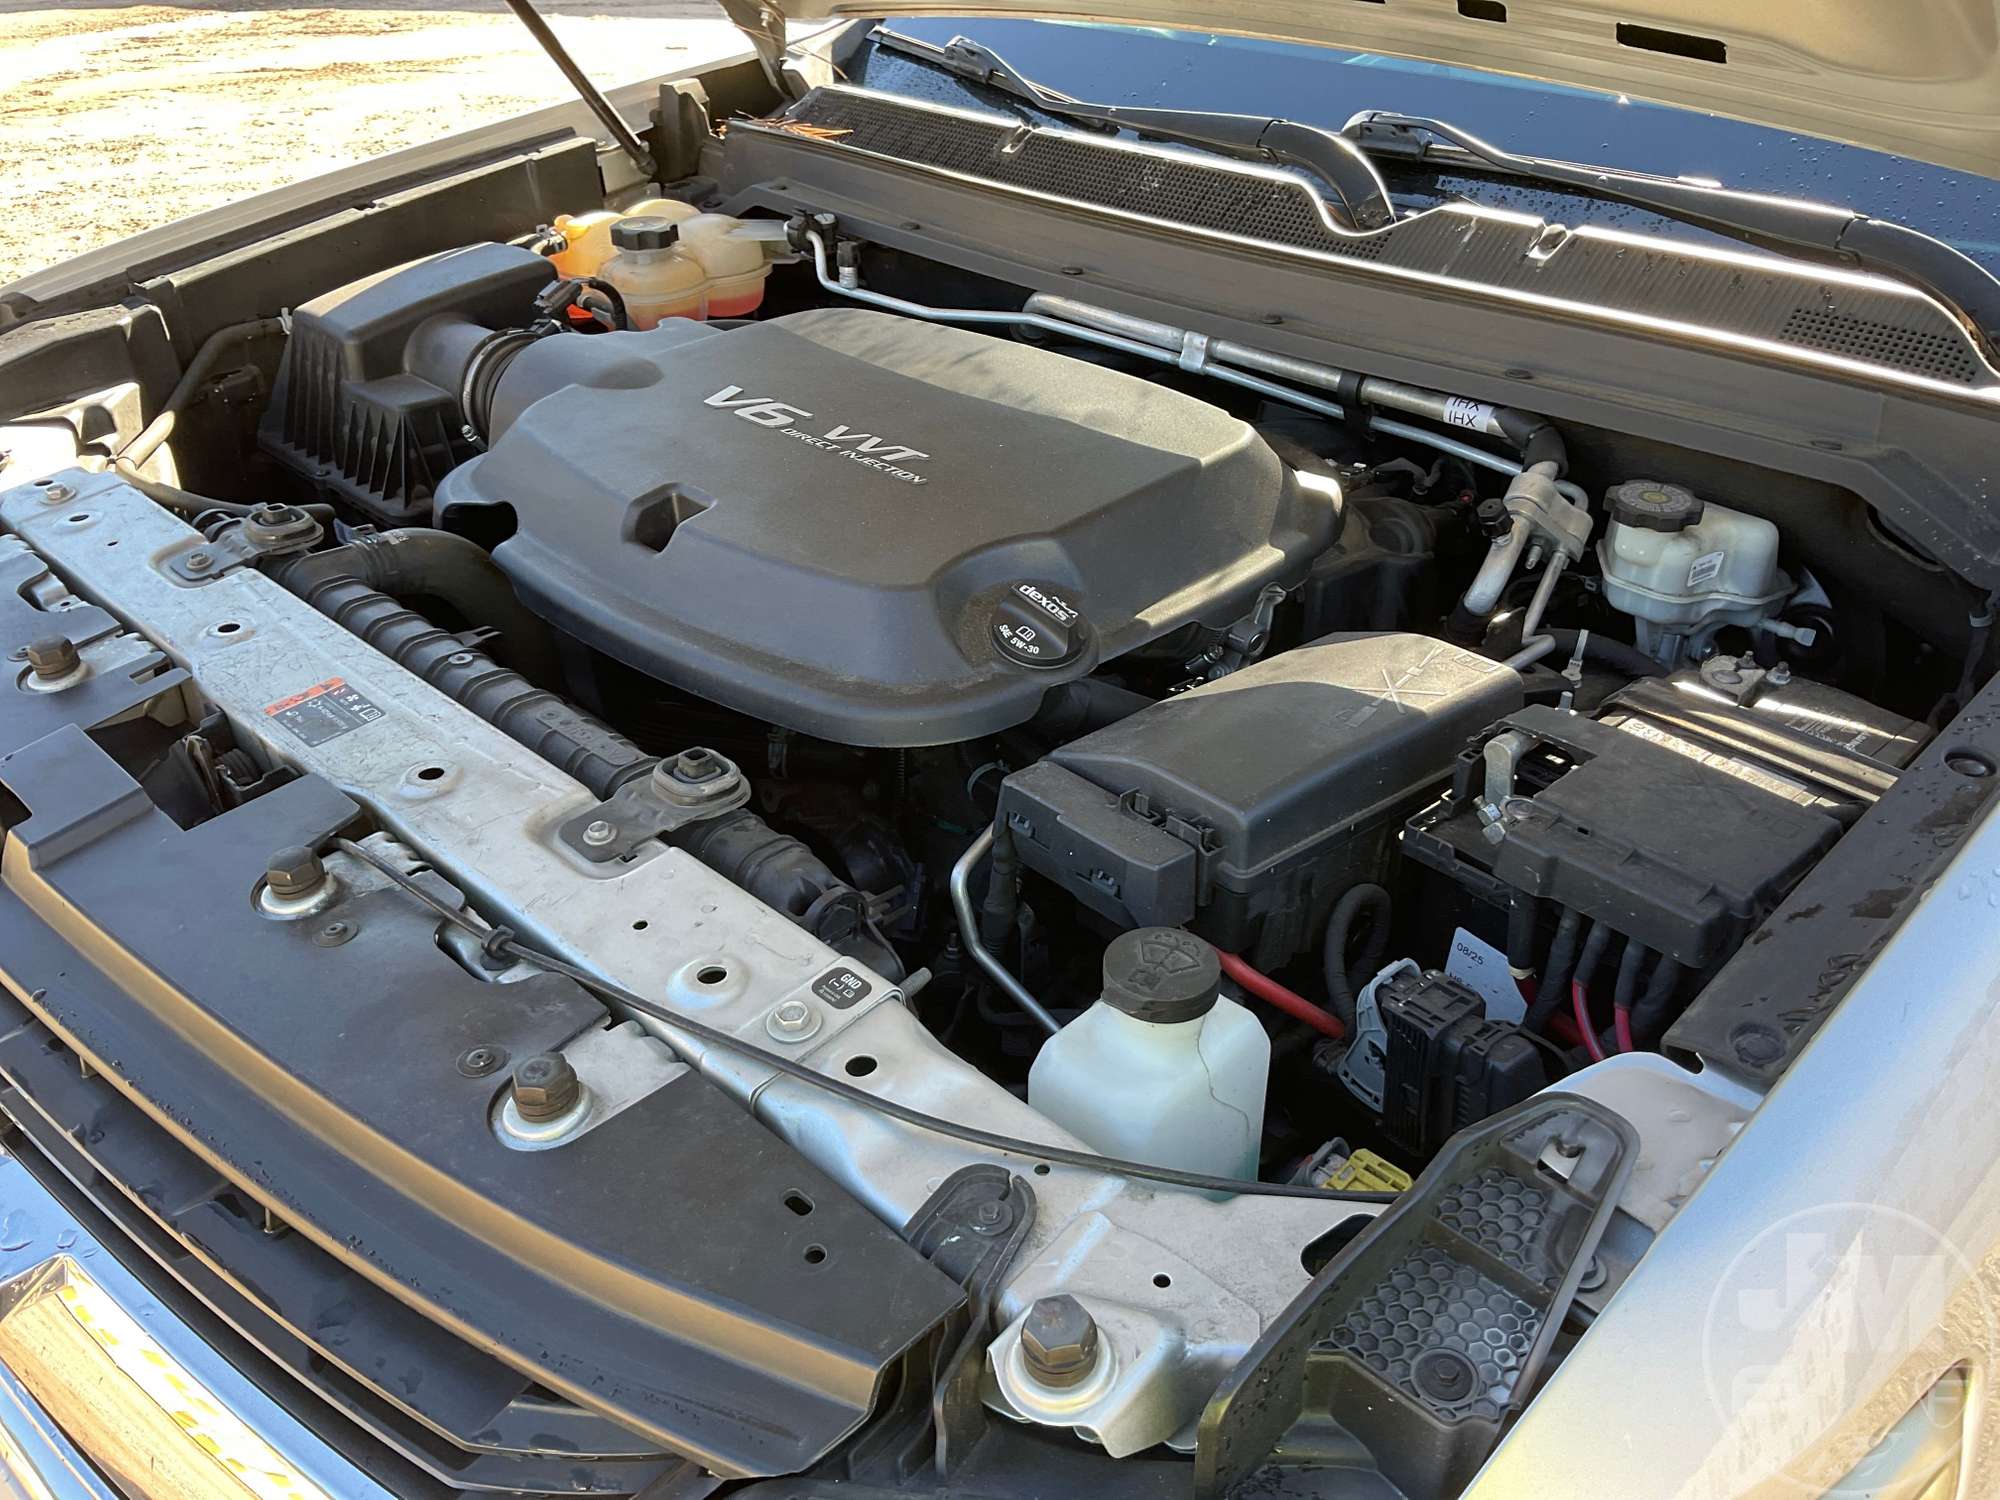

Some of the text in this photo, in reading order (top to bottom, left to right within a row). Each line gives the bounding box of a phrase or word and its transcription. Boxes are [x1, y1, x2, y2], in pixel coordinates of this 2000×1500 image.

[703, 384, 930, 463] V6 VVT
[1448, 410, 1477, 427] IHX
[779, 427, 928, 485] DIRECT INJECTION
[1019, 584, 1069, 621] dexos
[999, 624, 1040, 655] SAE 5W-30
[1456, 942, 1485, 966] 08/25
[840, 973, 862, 989] GND
